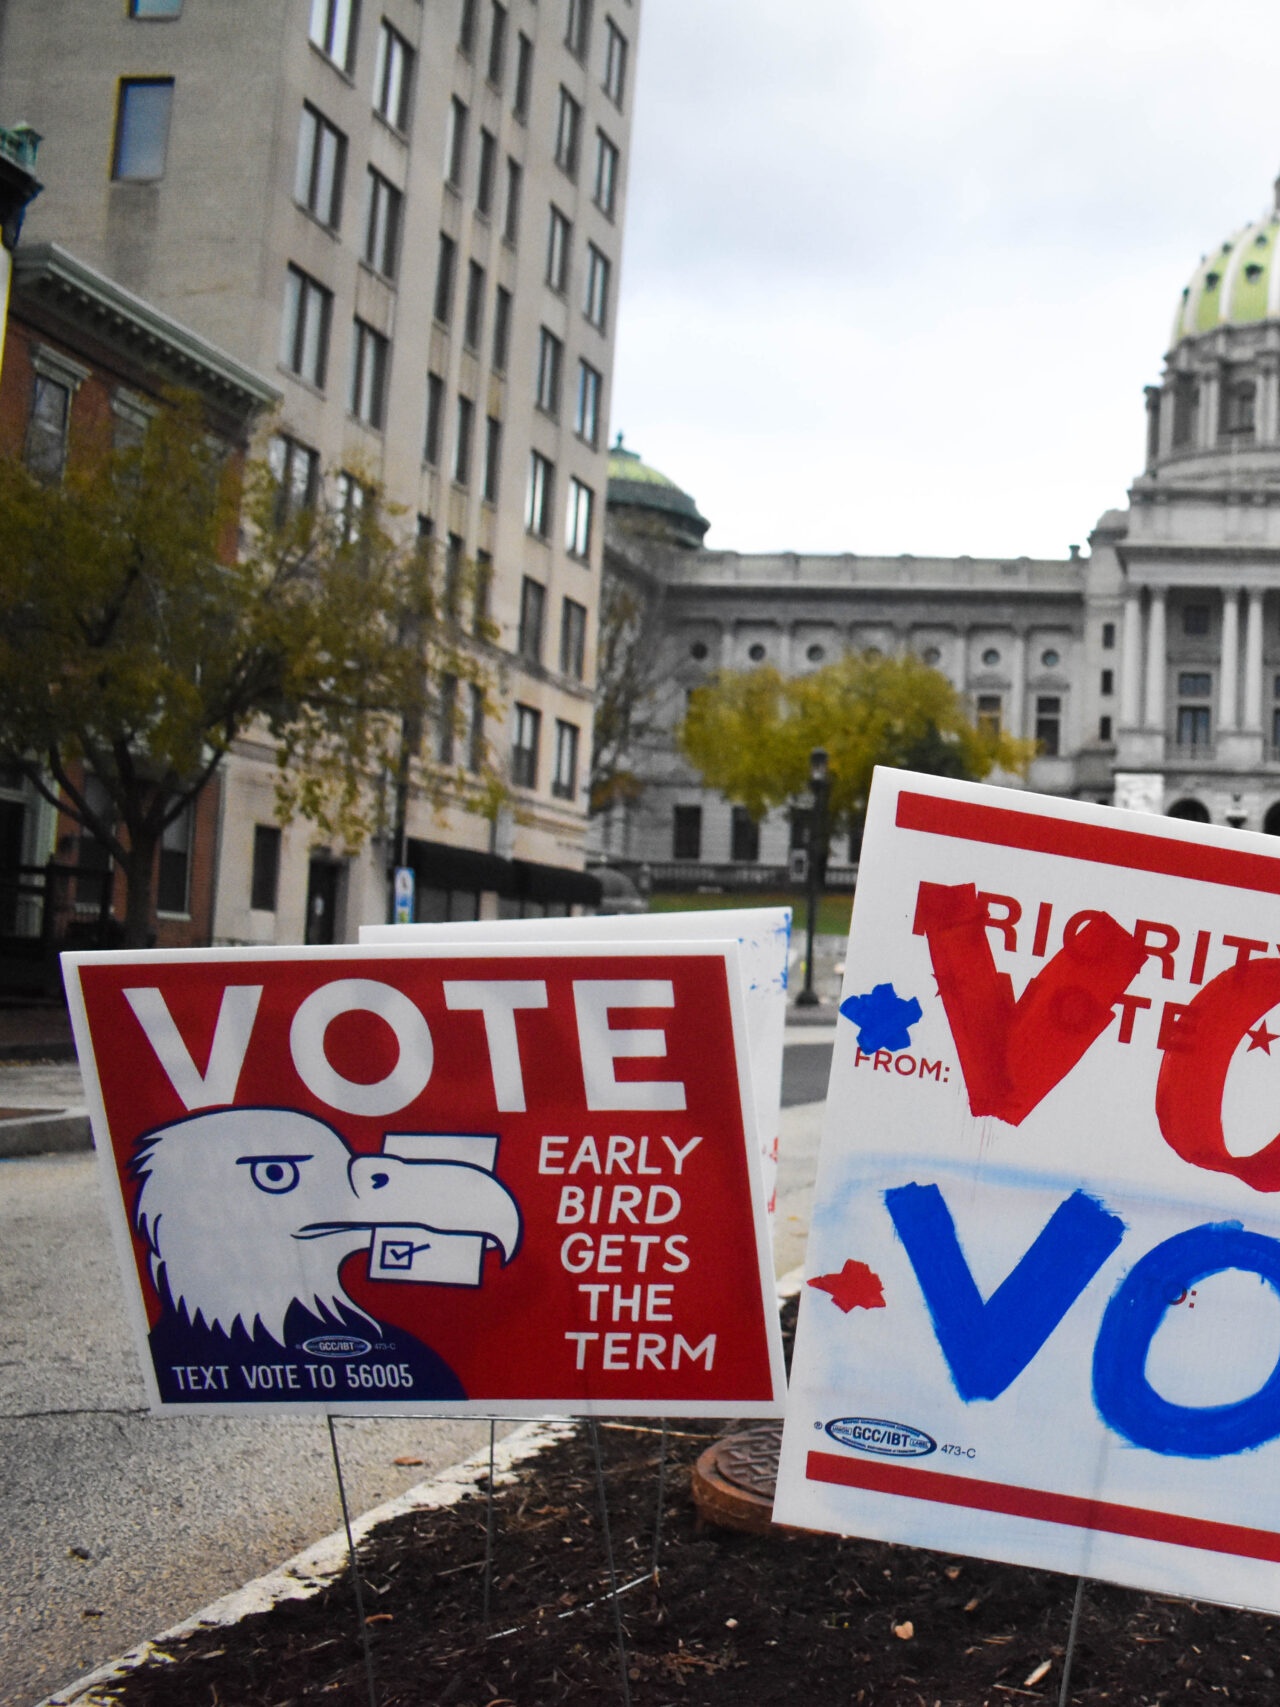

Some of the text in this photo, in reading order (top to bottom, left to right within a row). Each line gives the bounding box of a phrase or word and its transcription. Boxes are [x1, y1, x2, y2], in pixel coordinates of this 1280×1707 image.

[122, 978, 687, 1117] VOTE
[854, 1046, 950, 1083] FROM:
[538, 1136, 703, 1175] EARLY
[557, 1186, 681, 1225] BIRD
[561, 1233, 691, 1275] GETS
[578, 1283, 673, 1323] THE
[319, 1341, 354, 1351] GCC/IBT
[564, 1333, 717, 1372] TERM
[171, 1363, 414, 1390] TEXT VOTE TO 56005
[852, 1425, 910, 1447] GCC/IBT
[941, 1443, 976, 1459] 473-C
